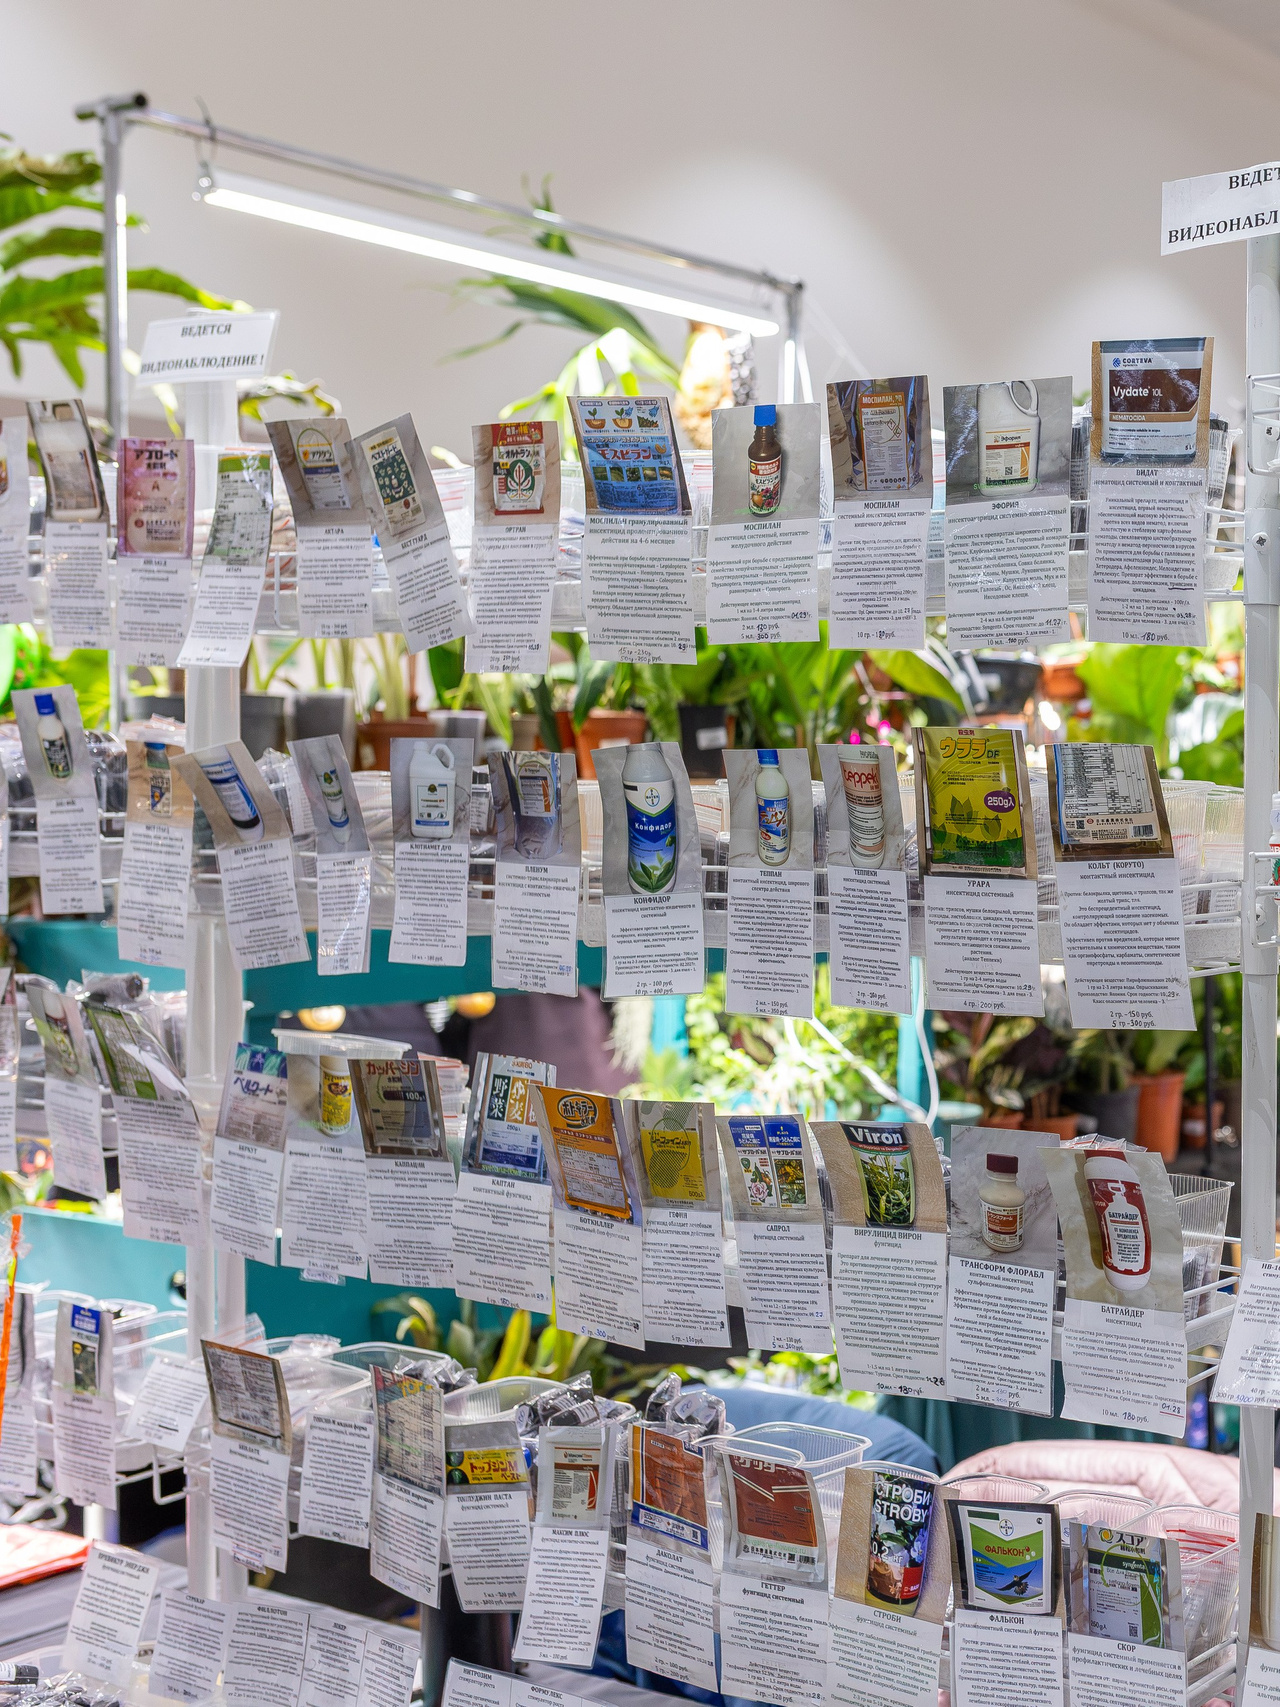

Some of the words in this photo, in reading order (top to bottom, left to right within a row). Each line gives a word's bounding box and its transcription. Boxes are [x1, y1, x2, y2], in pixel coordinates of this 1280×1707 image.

[181, 323, 231, 338] ВЕДЕТСЯ
[141, 355, 257, 375] ВИДЕОНАБЛЮДЕНИЕ
[1112, 386, 1149, 400] Vydate
[1152, 388, 1163, 397] 10L
[1136, 469, 1159, 477] ВИДАТ
[863, 500, 900, 510] МОСПИЛАН
[991, 500, 1020, 510] ЭФОРИЯ
[589, 517, 627, 526] МОСПИЛАН
[628, 518, 688, 527] гранулированный
[743, 522, 782, 532] МОСПИЛАН
[730, 540, 765, 550] желудочного
[766, 539, 792, 548] действия
[1156, 633, 1170, 642] руб.
[940, 736, 987, 759] ウララ
[987, 795, 1015, 809] 250g入
[634, 821, 672, 833] Конфидор
[525, 866, 549, 874] ПЛЕНУМ
[1087, 861, 1111, 870] КОЛЬТ
[1112, 861, 1145, 870] (КОРУТО)
[760, 870, 783, 878] ТЕППАН
[1079, 872, 1117, 880] контактный
[1118, 871, 1155, 880] инсектицид
[967, 879, 991, 889] УРАРА
[633, 894, 672, 905] КОНФИДОР
[945, 890, 980, 899] инсектицид
[981, 890, 1014, 899] системный
[849, 1126, 903, 1145] Viron
[491, 1178, 516, 1189] КАПТАН
[472, 1186, 505, 1197] контактный
[505, 1189, 532, 1201] фунгицид
[1108, 1211, 1139, 1220] БАТРАЙДЕР
[579, 1216, 615, 1230] БОТКИЛЛЕР
[766, 1224, 791, 1233] САПРОЛ
[853, 1228, 898, 1240] ВИРУЛИЦИД
[898, 1231, 922, 1241] ВИРОН
[874, 1239, 902, 1249] фунгицид
[960, 1259, 1006, 1274] ТРАНСФОРМ
[1006, 1265, 1044, 1280] ФЛОРАБЛ
[969, 1270, 1001, 1282] контактный
[1001, 1276, 1034, 1287] инсектицид
[1101, 1305, 1145, 1319] БАТРАЙДЕР
[1105, 1318, 1142, 1329] инсектицид
[493, 1493, 513, 1501] ПАСТА
[875, 1480, 931, 1506] СТРОБИ
[873, 1498, 929, 1523] STROBY
[552, 1529, 573, 1537] МАКСИМ
[1115, 1533, 1145, 1548] スコア
[656, 1548, 684, 1563] ДАКОЛАТ
[984, 1545, 1024, 1558] ФАЛЬКОН
[1121, 1560, 1146, 1572] syngenta
[760, 1582, 786, 1593] ГЕТТЕР
[742, 1587, 771, 1600] фунгицид
[771, 1593, 805, 1605] системный
[873, 1610, 902, 1624] СТРОБИ
[988, 1614, 1025, 1625] ФАЛЬКОН
[885, 1624, 918, 1637] системный
[1033, 1628, 1060, 1638] фунгицид
[1116, 1642, 1137, 1653] СКОР
[1072, 1656, 1128, 1671] профилактических
[1103, 1651, 1136, 1662] системный
[1137, 1656, 1177, 1670] применяется
[462, 1668, 492, 1680] НИТРОЗИМ
